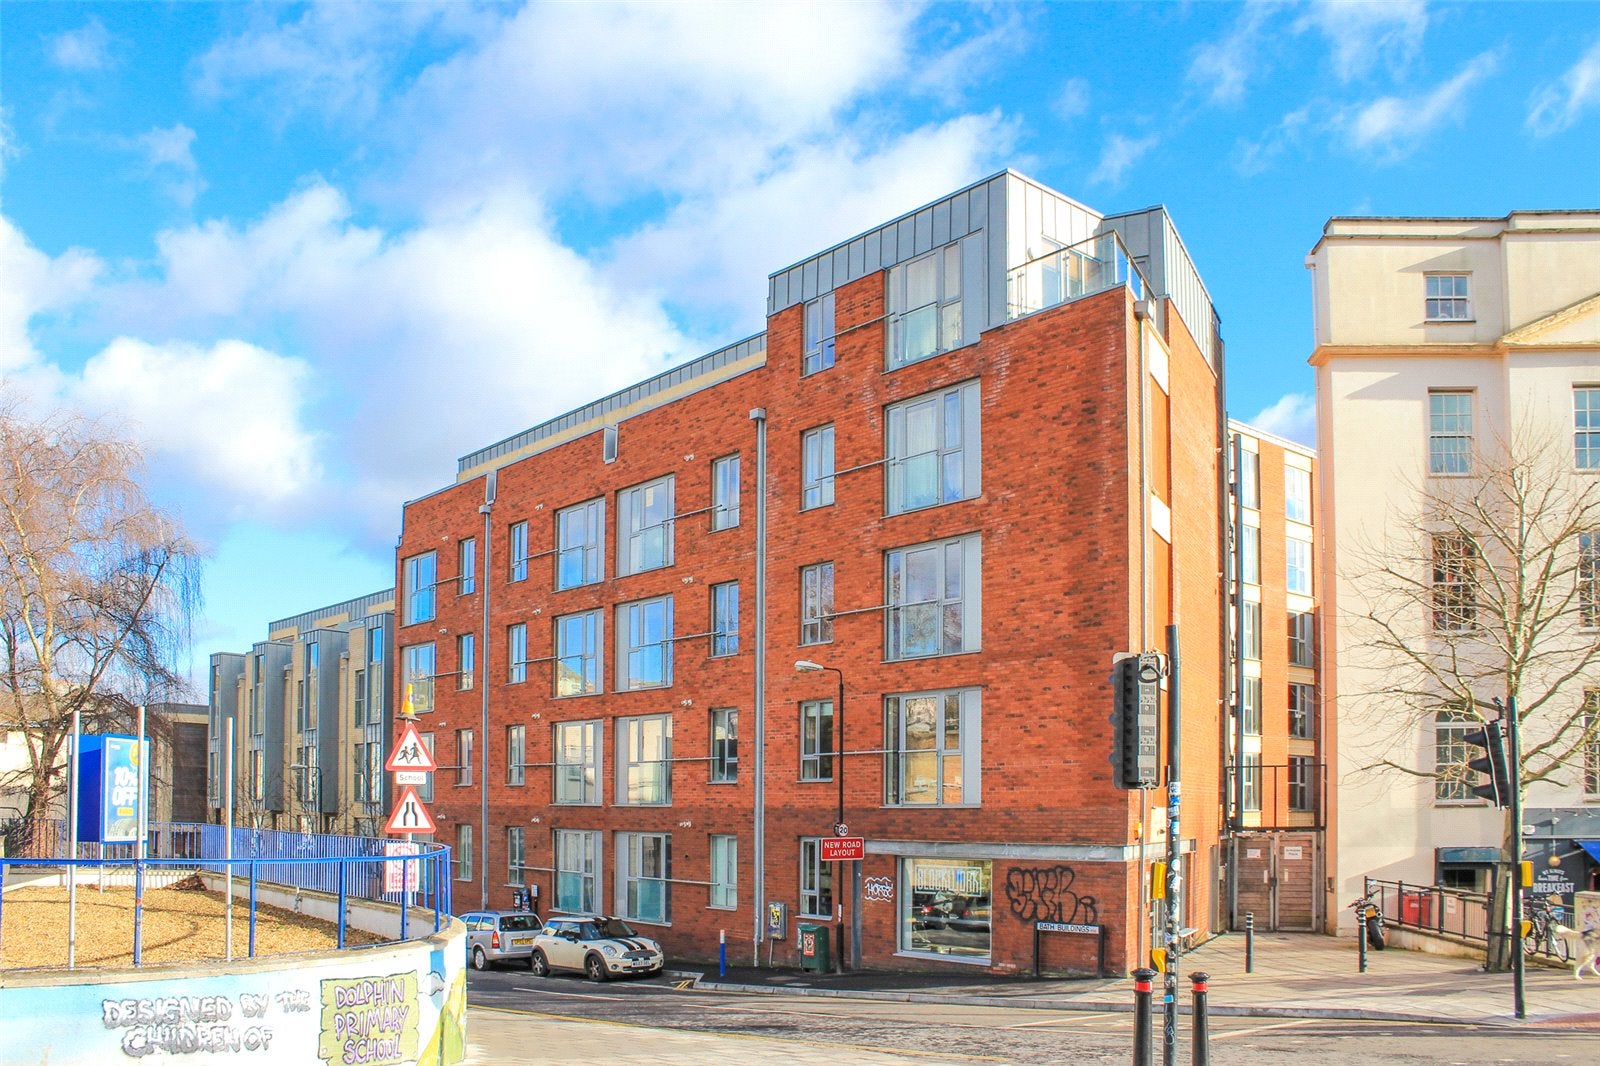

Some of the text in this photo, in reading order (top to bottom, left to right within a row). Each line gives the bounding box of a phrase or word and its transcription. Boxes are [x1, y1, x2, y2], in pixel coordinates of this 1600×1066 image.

[112, 785, 138, 806] OFF
[839, 826, 848, 834] 20
[824, 841, 841, 849] NEW
[829, 849, 856, 857] LAYOUT
[917, 868, 979, 893] BLOCKWORK
[1532, 882, 1575, 893] BREAKFAST
[1039, 922, 1055, 930] BATH
[1057, 924, 1090, 932] BUILDINGS
[334, 978, 405, 1009] DOLPHIN
[102, 996, 233, 1030] DESIGNED
[239, 992, 268, 1019] BY
[333, 1005, 410, 1041] PRIMARY
[242, 1025, 273, 1051] OF
[342, 1033, 402, 1064] SCHOOL
